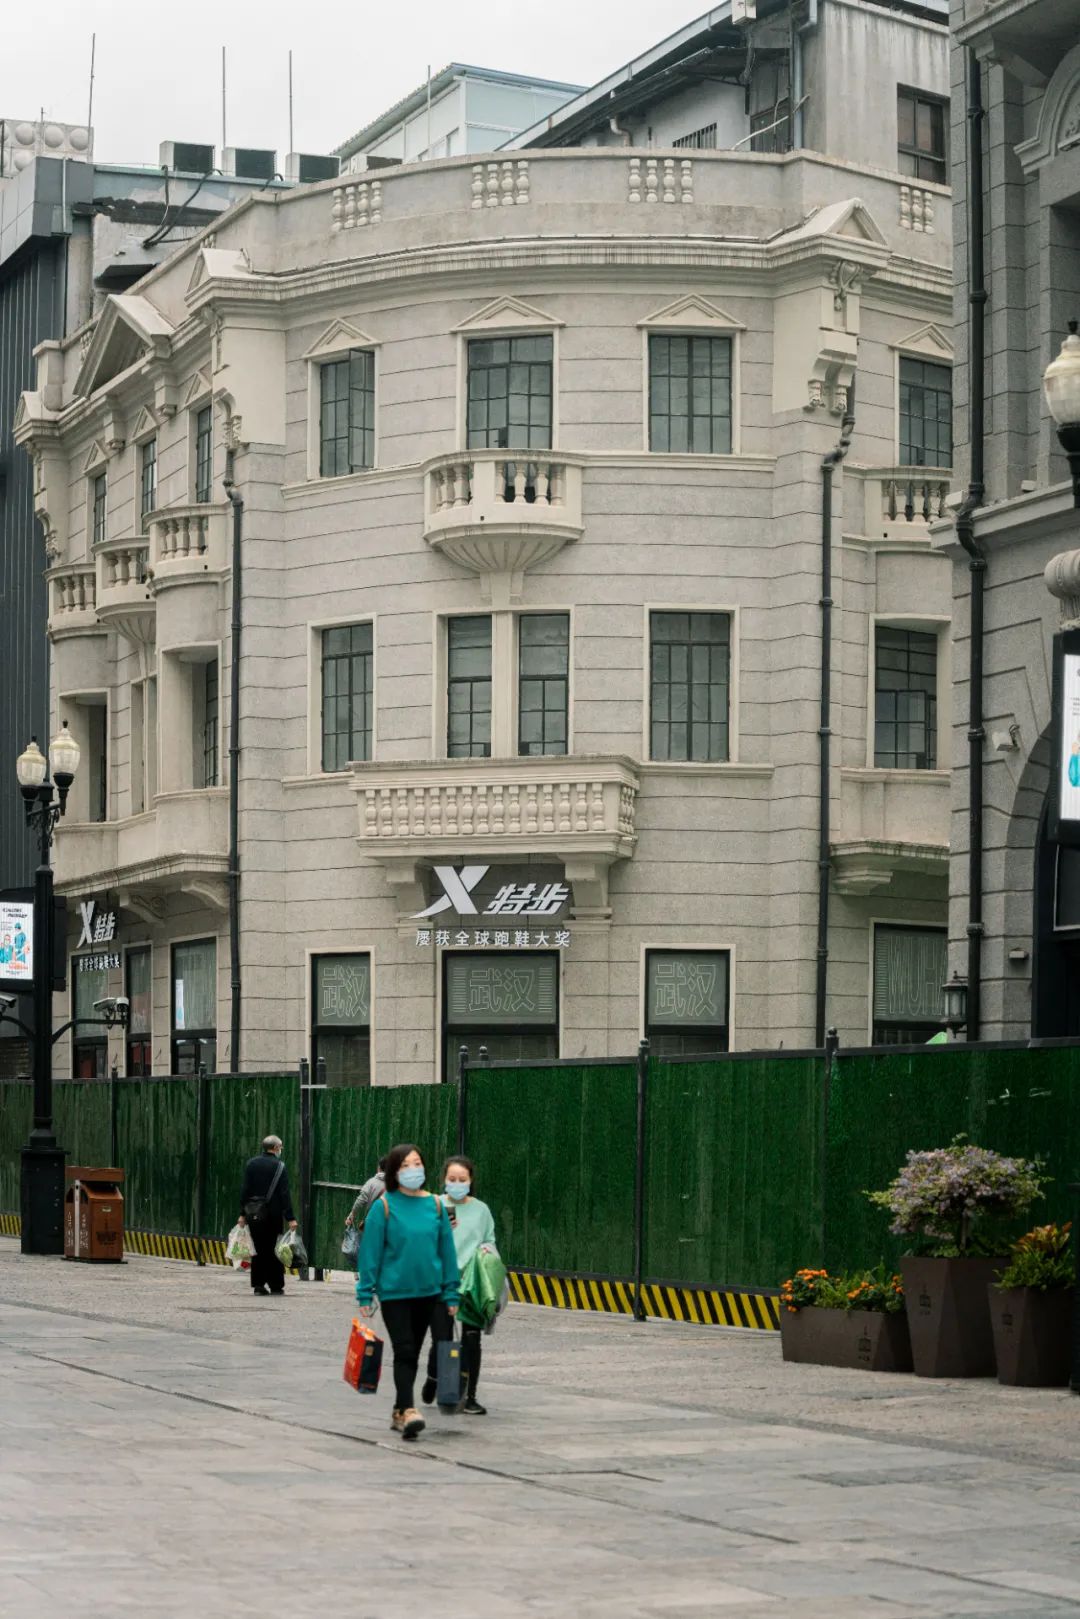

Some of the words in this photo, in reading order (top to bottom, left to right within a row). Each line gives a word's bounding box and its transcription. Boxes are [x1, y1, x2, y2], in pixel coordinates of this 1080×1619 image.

[482, 883, 569, 914] 特步
[94, 912, 116, 942] 特步
[416, 930, 571, 947] 屡获全球跑鞋大奖
[322, 964, 367, 1018] 武汉
[469, 968, 535, 1012] 武汉
[655, 962, 717, 1017] 武汉
